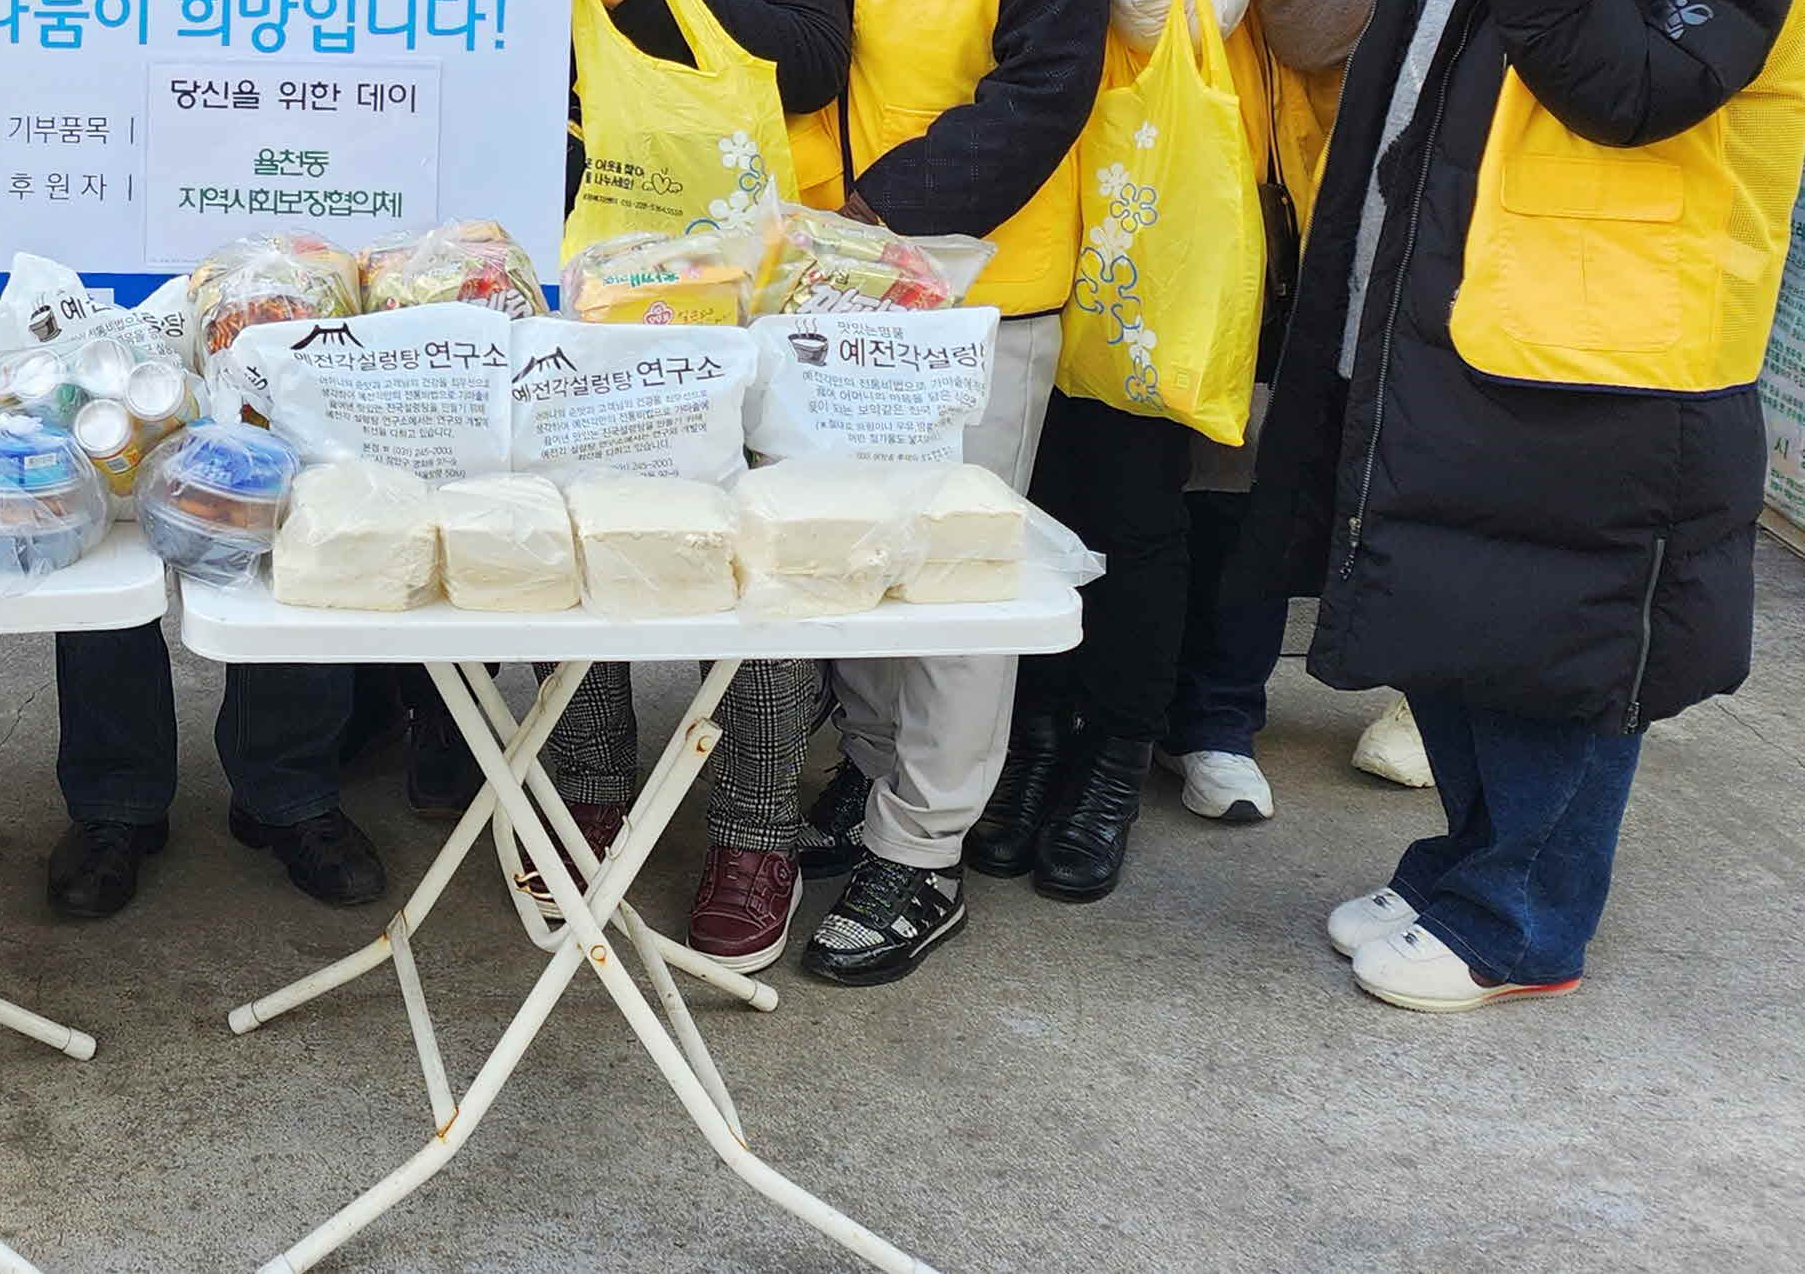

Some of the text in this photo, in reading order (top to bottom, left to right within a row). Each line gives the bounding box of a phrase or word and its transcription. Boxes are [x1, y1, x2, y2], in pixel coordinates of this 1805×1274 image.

[171, 79, 417, 114] 당신을 위한 데이
[8, 116, 111, 145] 기부품목
[253, 147, 329, 178] 율천동
[178, 187, 403, 218] 지역사회보장협의체
[295, 340, 509, 372] 예전각설렁탕 연구소
[839, 337, 987, 373] 예전각설렁
[511, 356, 725, 404] 예전각설렁탕 연구소
